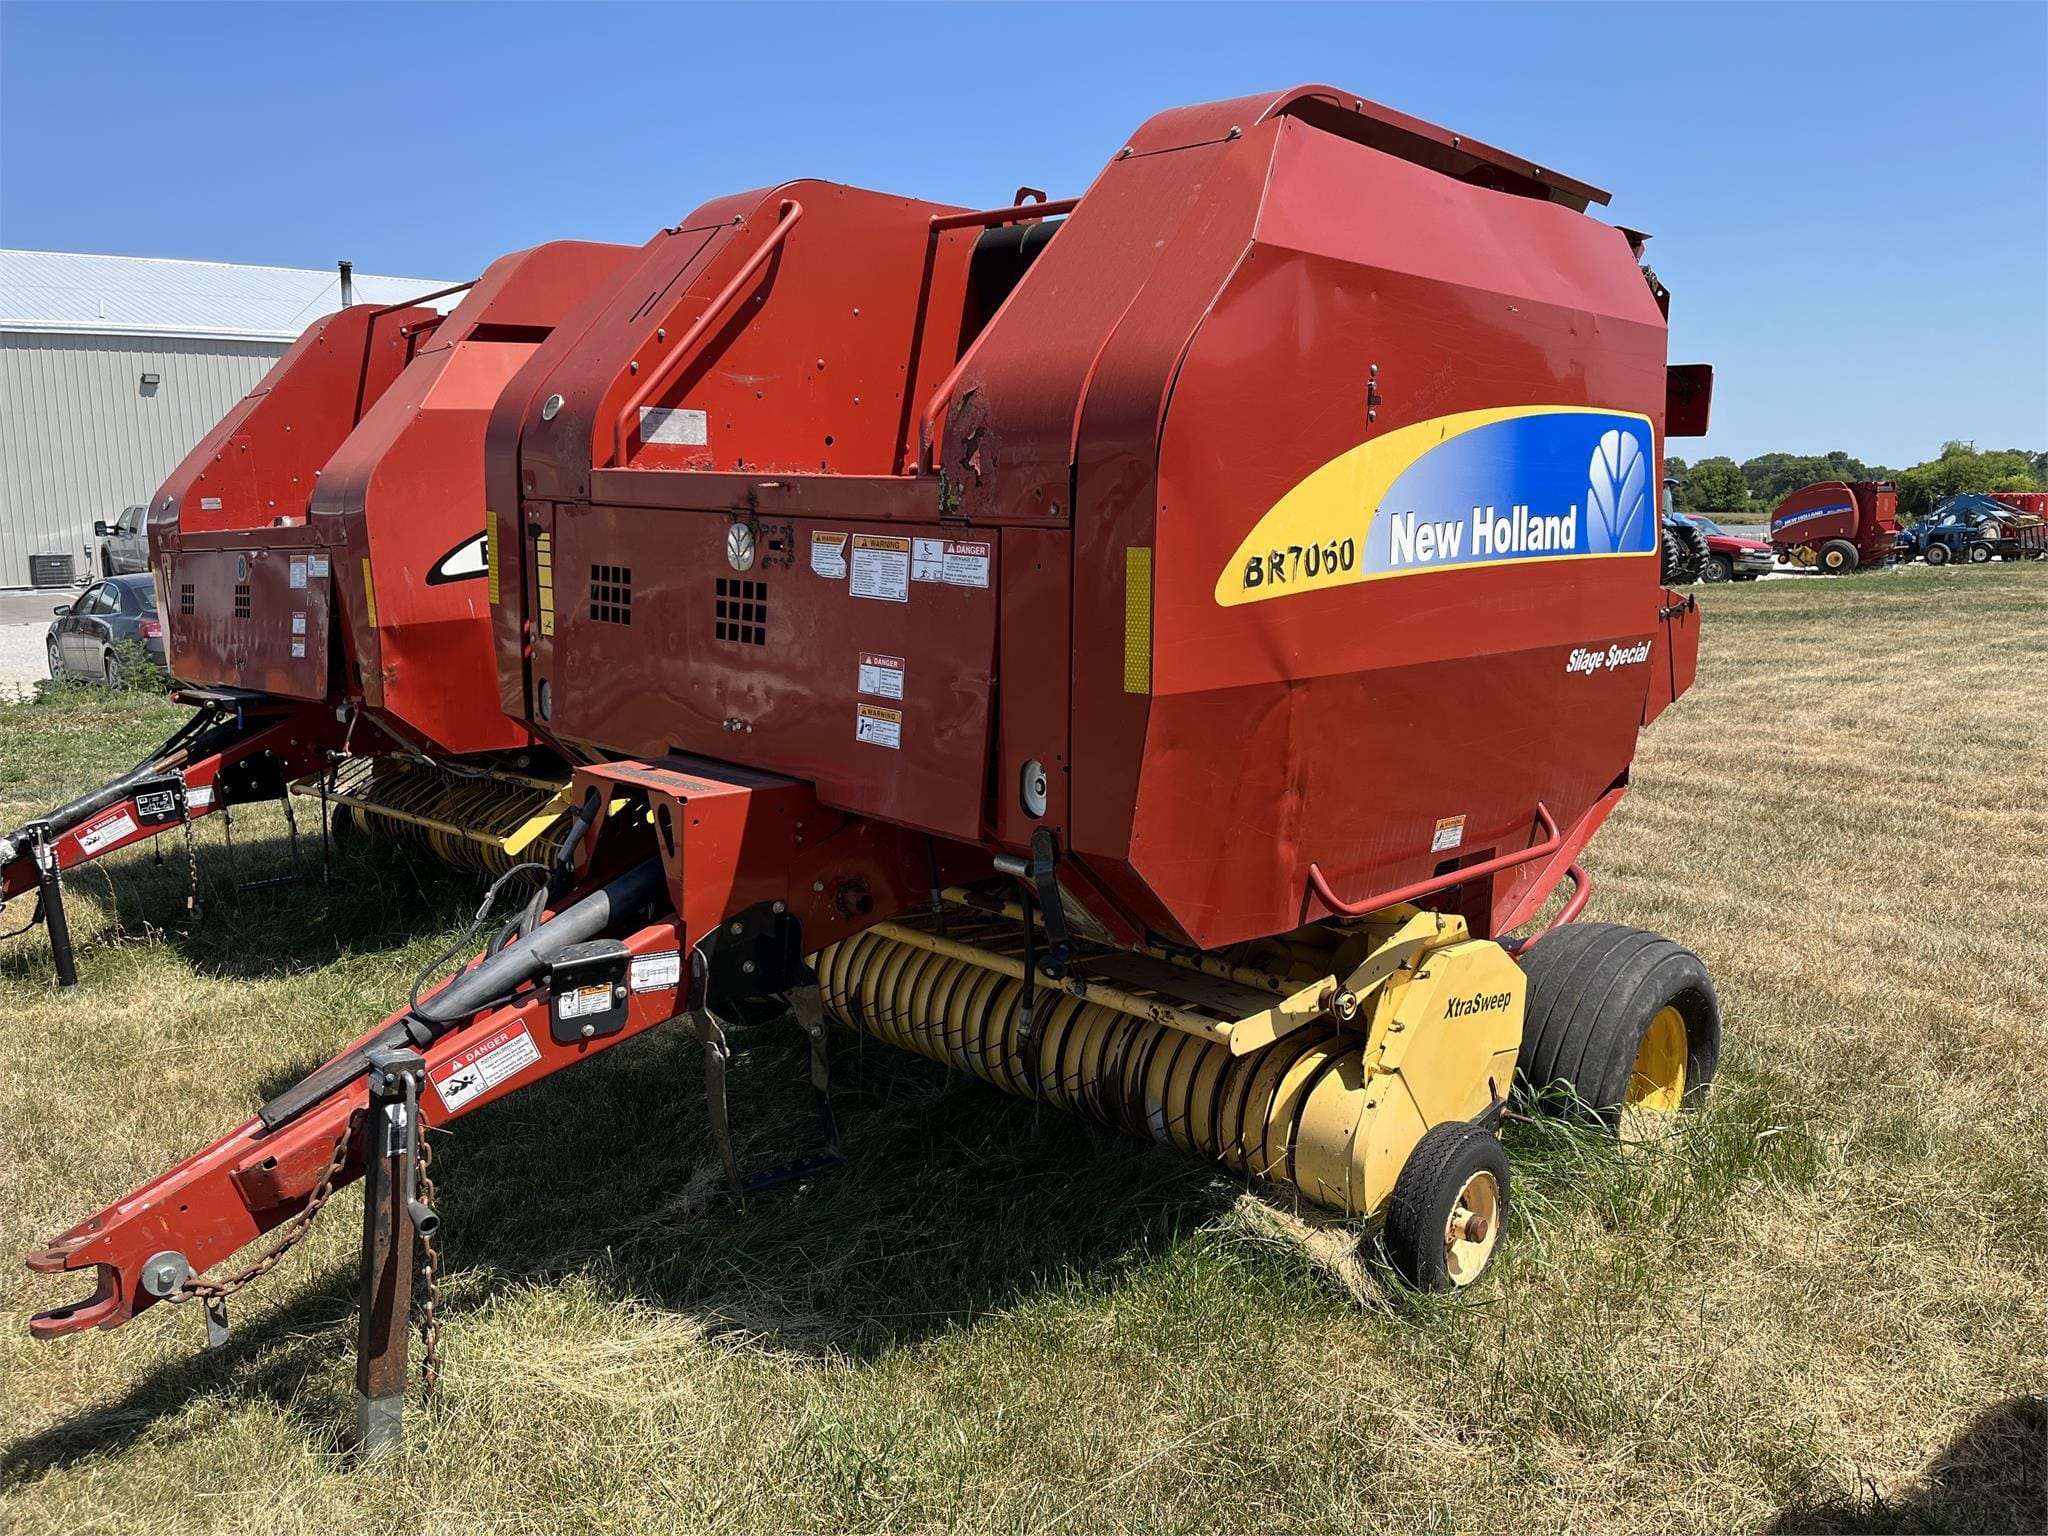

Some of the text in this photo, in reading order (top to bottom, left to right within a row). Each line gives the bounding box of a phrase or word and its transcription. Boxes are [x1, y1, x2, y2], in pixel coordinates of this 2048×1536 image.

[870, 540, 900, 550] WARNING
[1389, 505, 1577, 565] New Holland
[956, 545, 986, 556] DANGER
[1243, 537, 1355, 591] BR7060
[873, 657, 898, 668] DANGER
[1566, 640, 1652, 676] Silage Special
[867, 708, 896, 720] WARNING
[1444, 992, 1511, 1019] XtraSweep
[466, 1033, 509, 1061] DANGER
